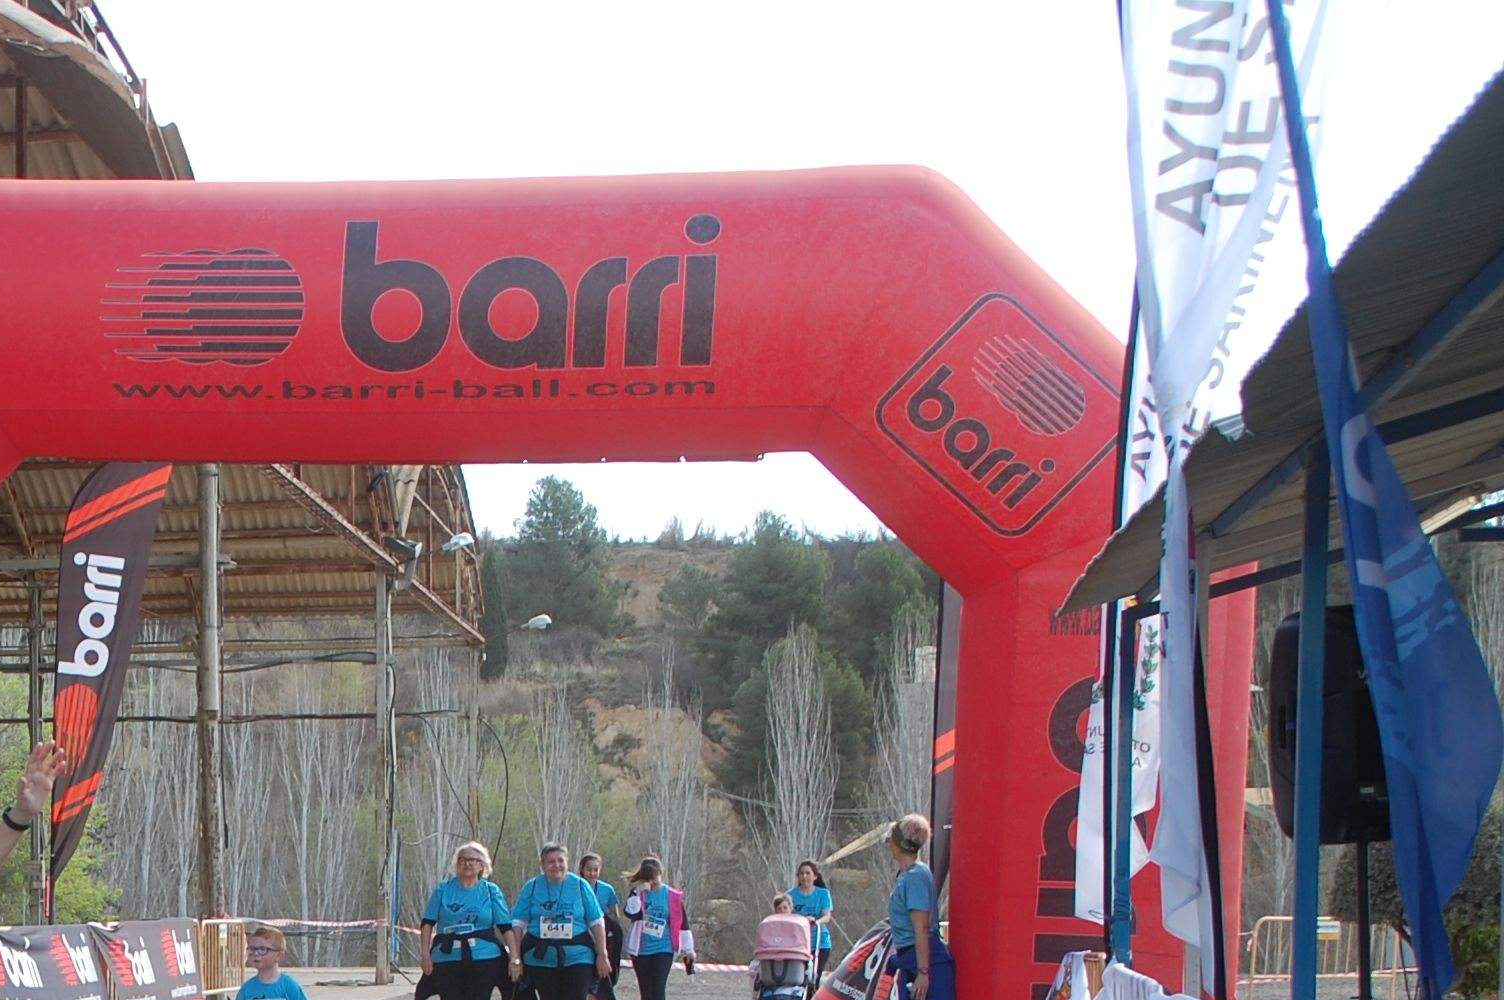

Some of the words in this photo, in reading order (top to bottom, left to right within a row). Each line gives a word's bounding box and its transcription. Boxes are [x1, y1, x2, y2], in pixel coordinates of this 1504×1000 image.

[340, 212, 723, 374] barri
[112, 377, 718, 401] www.barri-ball.com
[905, 362, 1057, 512] barri
[57, 551, 126, 678] barri
